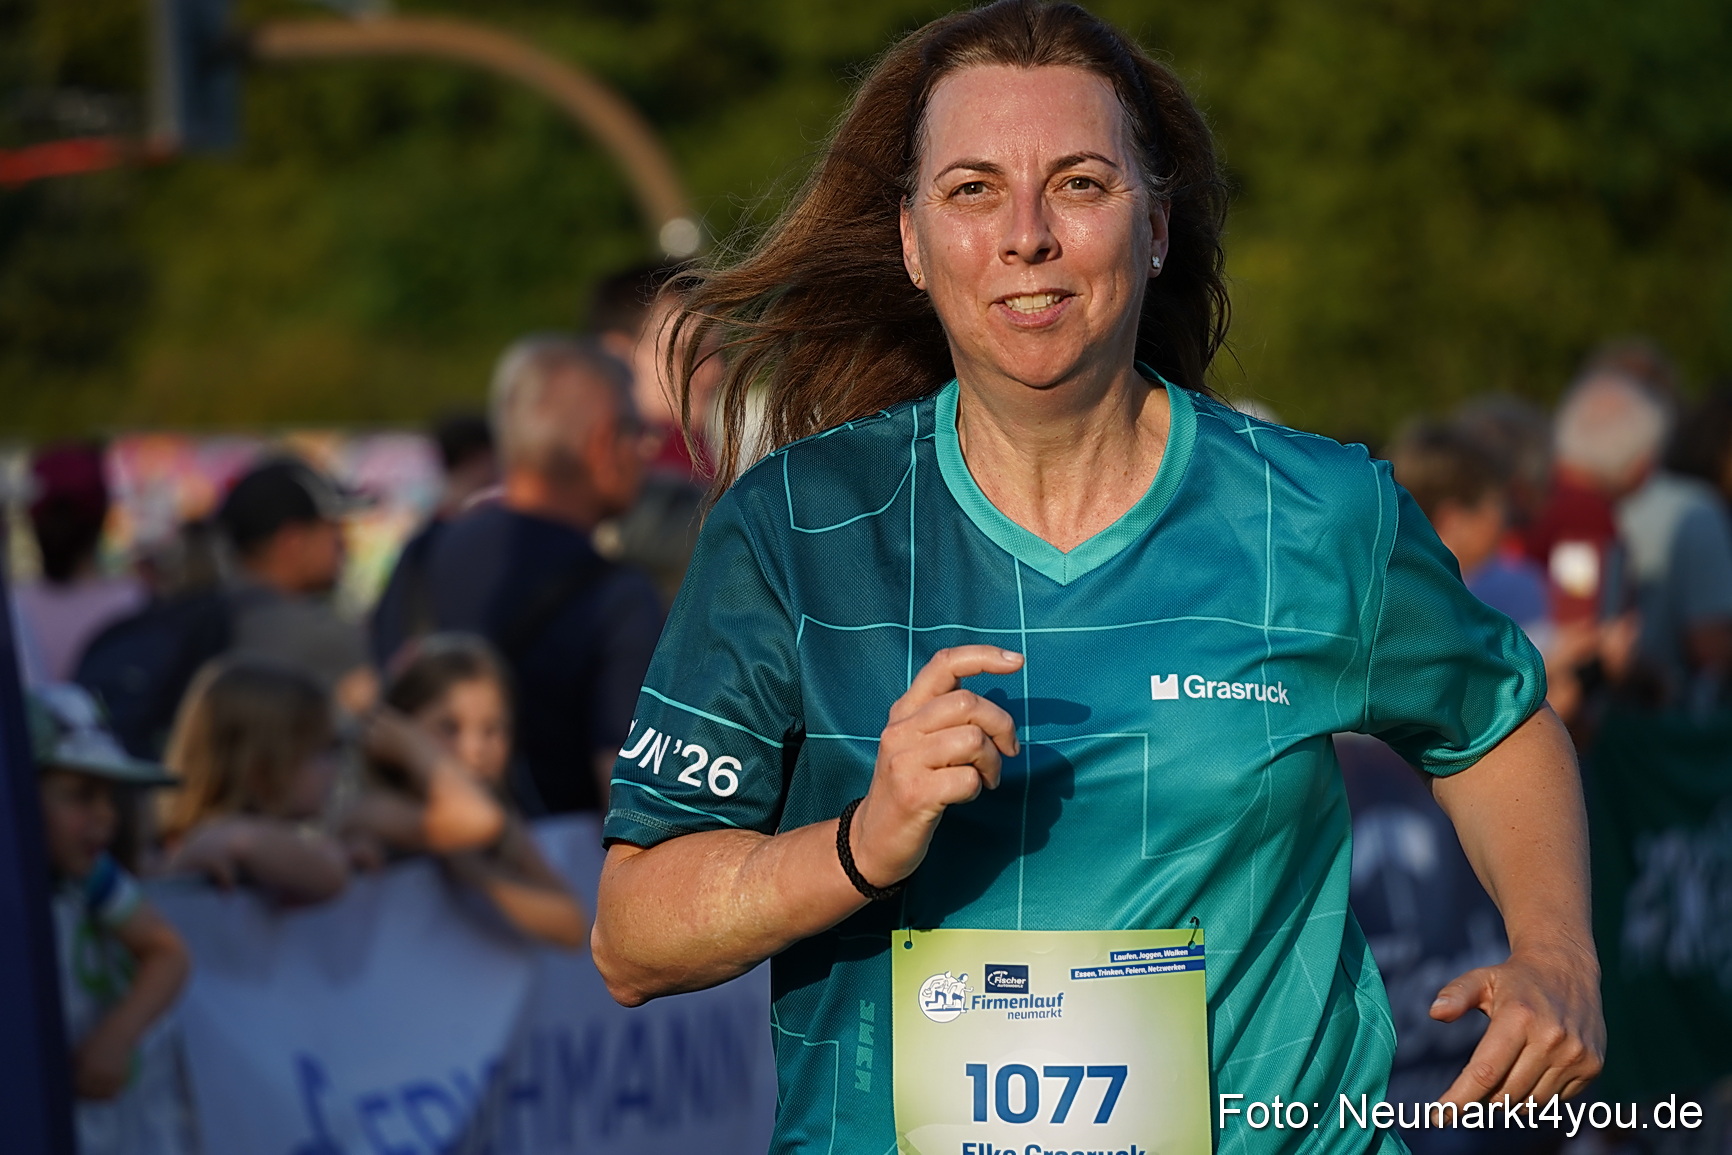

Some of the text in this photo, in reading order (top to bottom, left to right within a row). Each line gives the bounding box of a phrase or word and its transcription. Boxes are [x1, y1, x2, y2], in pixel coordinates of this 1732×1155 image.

[1183, 674, 1290, 706] Grasruck
[618, 718, 743, 798] UN'26
[1113, 949, 1188, 961] Laufen, Joggen, Walken
[1074, 964, 1186, 978] Essen, Trinken, Feiern, Netzwerken
[993, 974, 1027, 985] Fischer
[971, 992, 1064, 1010] Firmenlauf
[1007, 1008, 1063, 1020] neumarkt
[965, 1063, 1128, 1124] 1077
